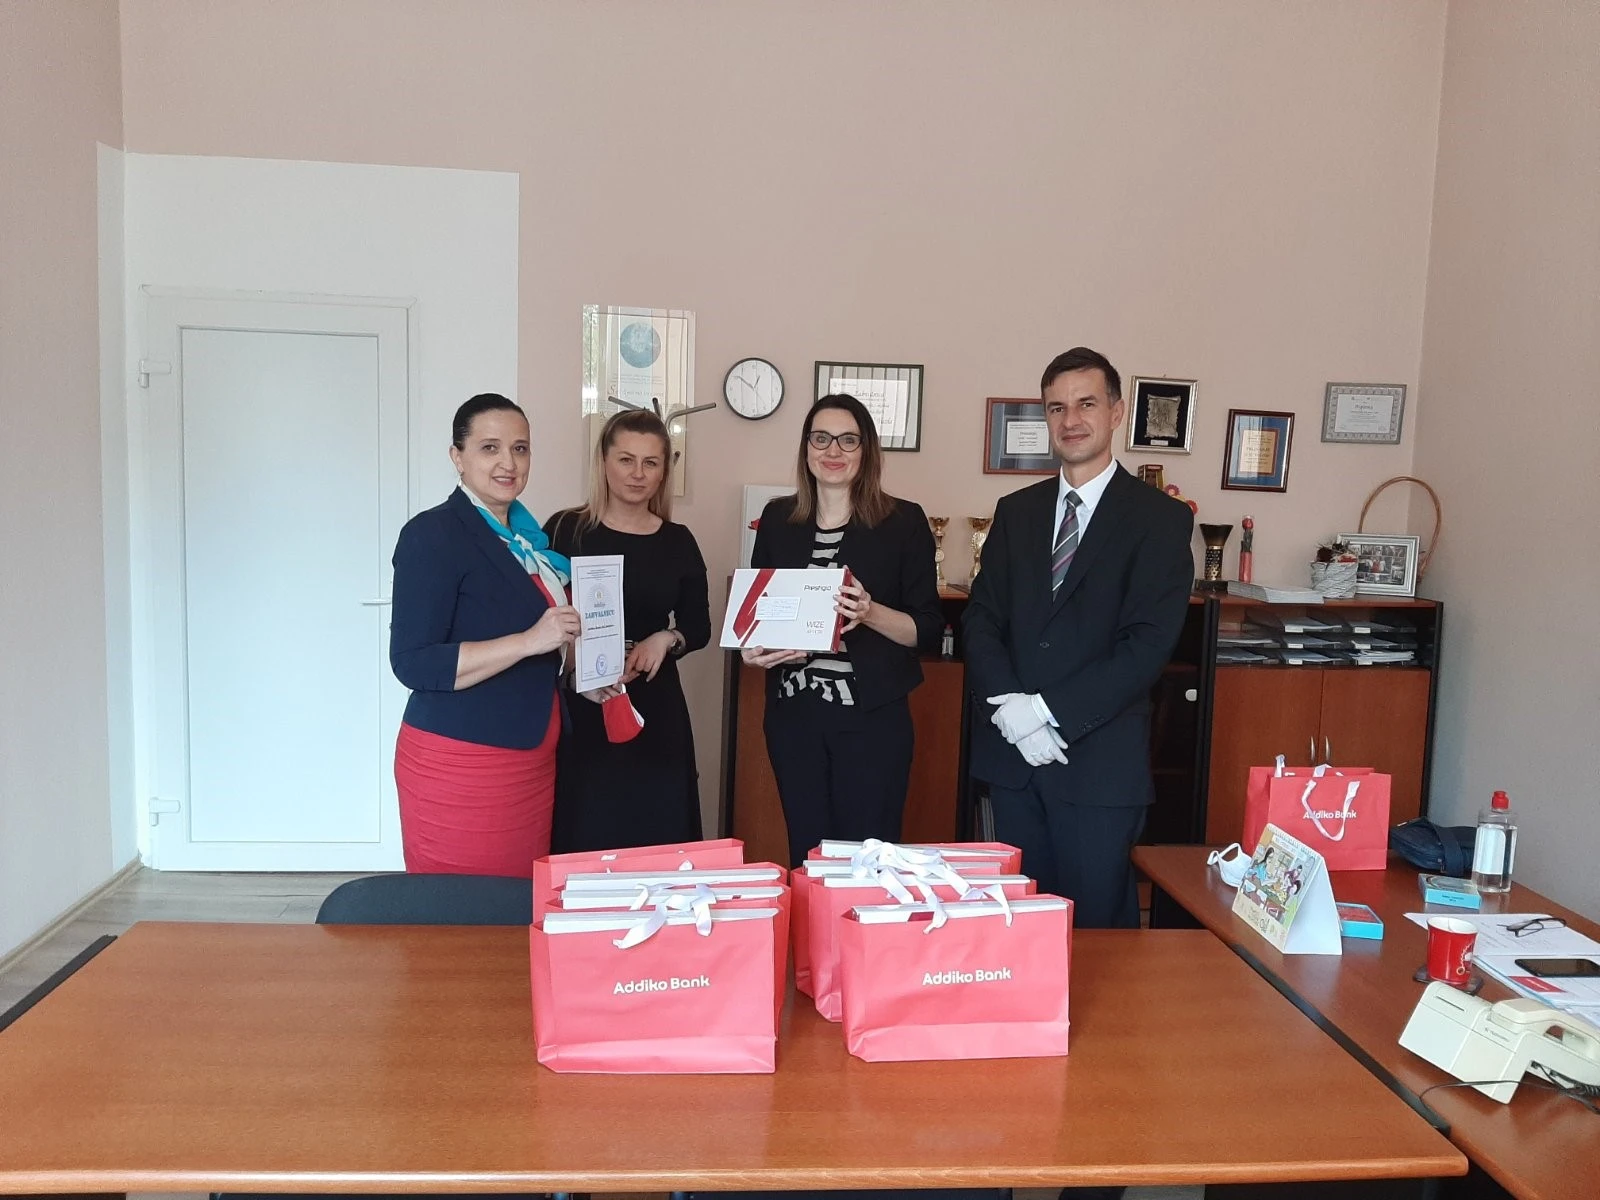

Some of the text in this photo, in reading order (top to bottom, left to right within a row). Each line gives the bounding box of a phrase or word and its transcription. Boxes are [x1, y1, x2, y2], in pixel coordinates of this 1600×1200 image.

[613, 974, 710, 995] Addiko Bank
[922, 967, 1012, 986] Addiko Bank
